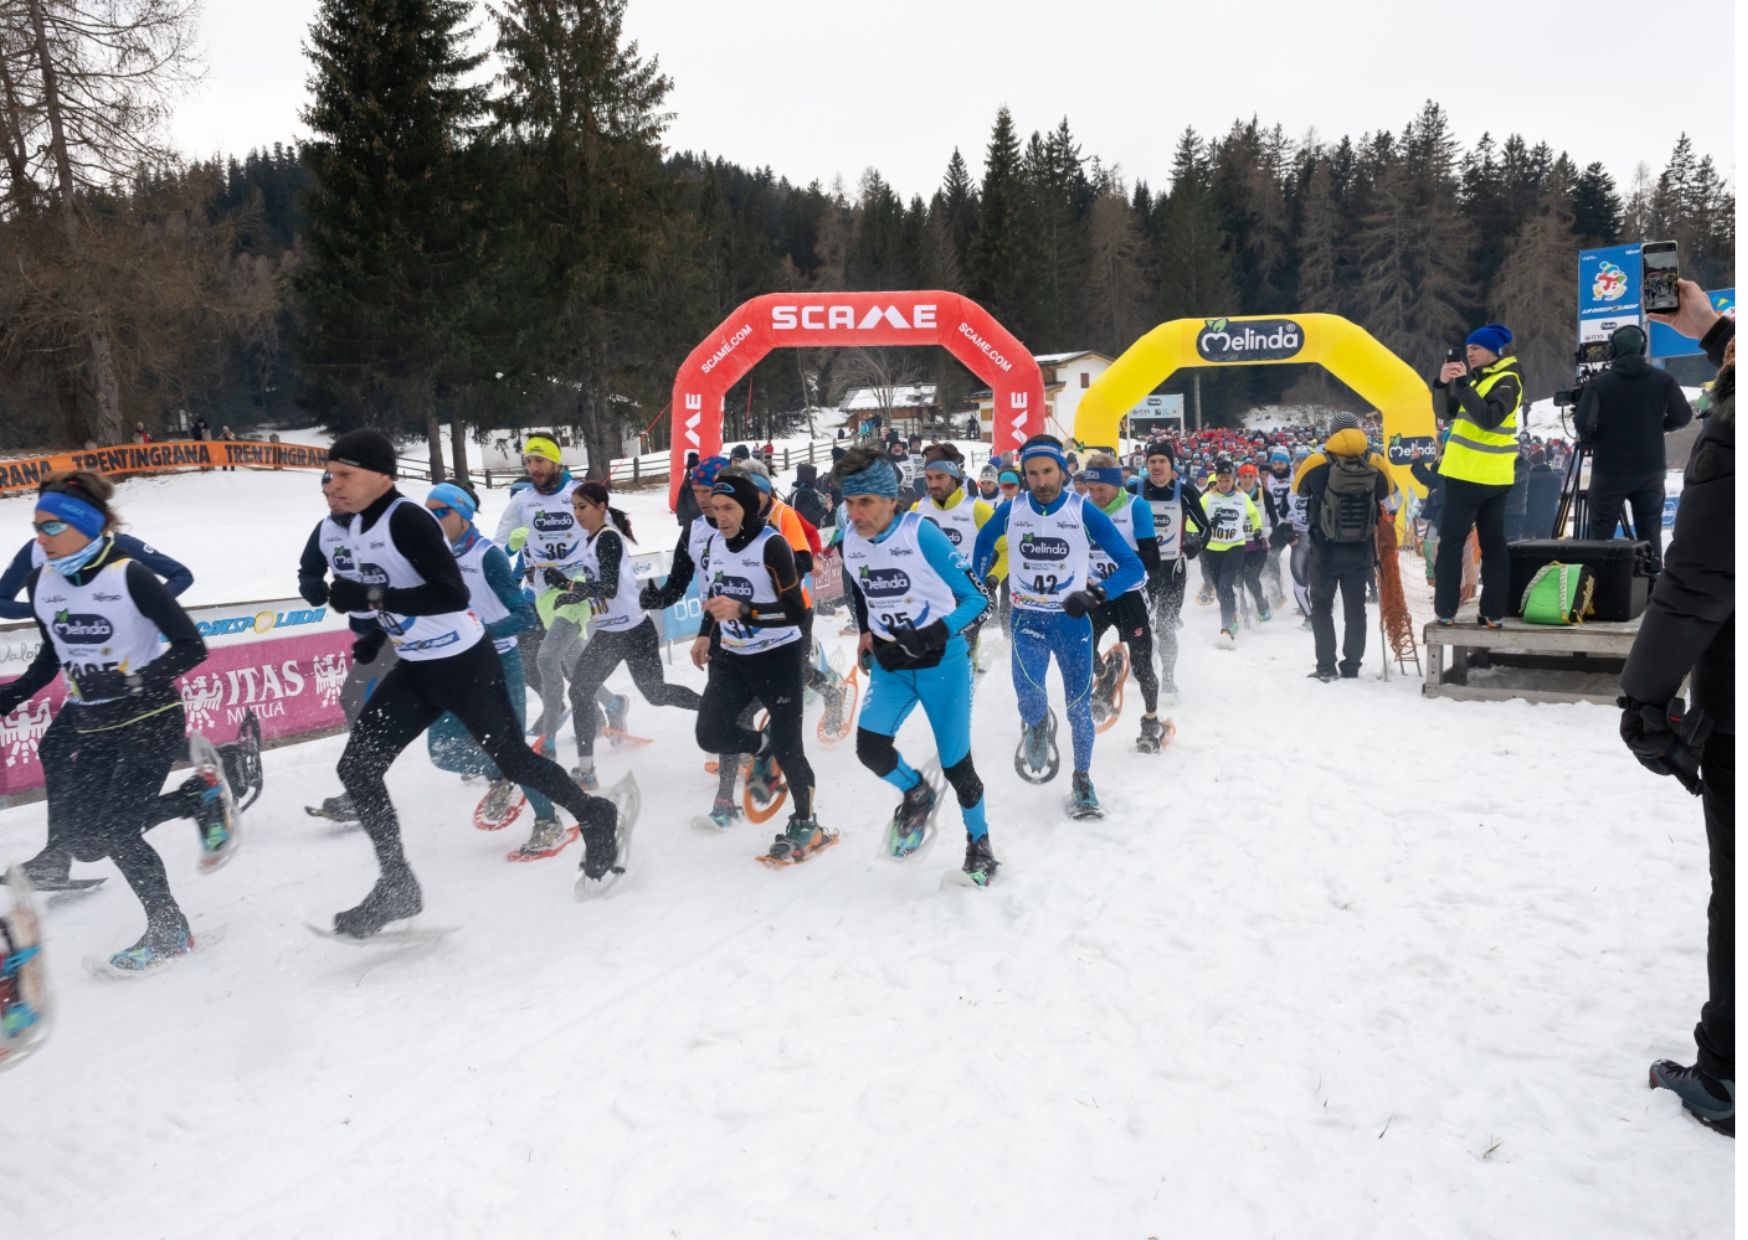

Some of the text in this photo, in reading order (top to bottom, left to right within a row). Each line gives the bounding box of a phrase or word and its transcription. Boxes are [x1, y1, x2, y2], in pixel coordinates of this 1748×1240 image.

[771, 304, 937, 330] SCAME
[701, 324, 753, 374] SCAME.COM
[958, 322, 1012, 372] SCAME.COM
[1201, 326, 1299, 352] Melinda
[535, 513, 572, 527] Melinda
[544, 542, 568, 560] 36
[1021, 541, 1068, 555] Melinda
[861, 574, 908, 590] Melinda
[1033, 575, 1059, 595] 42
[225, 659, 305, 706] ITAS
